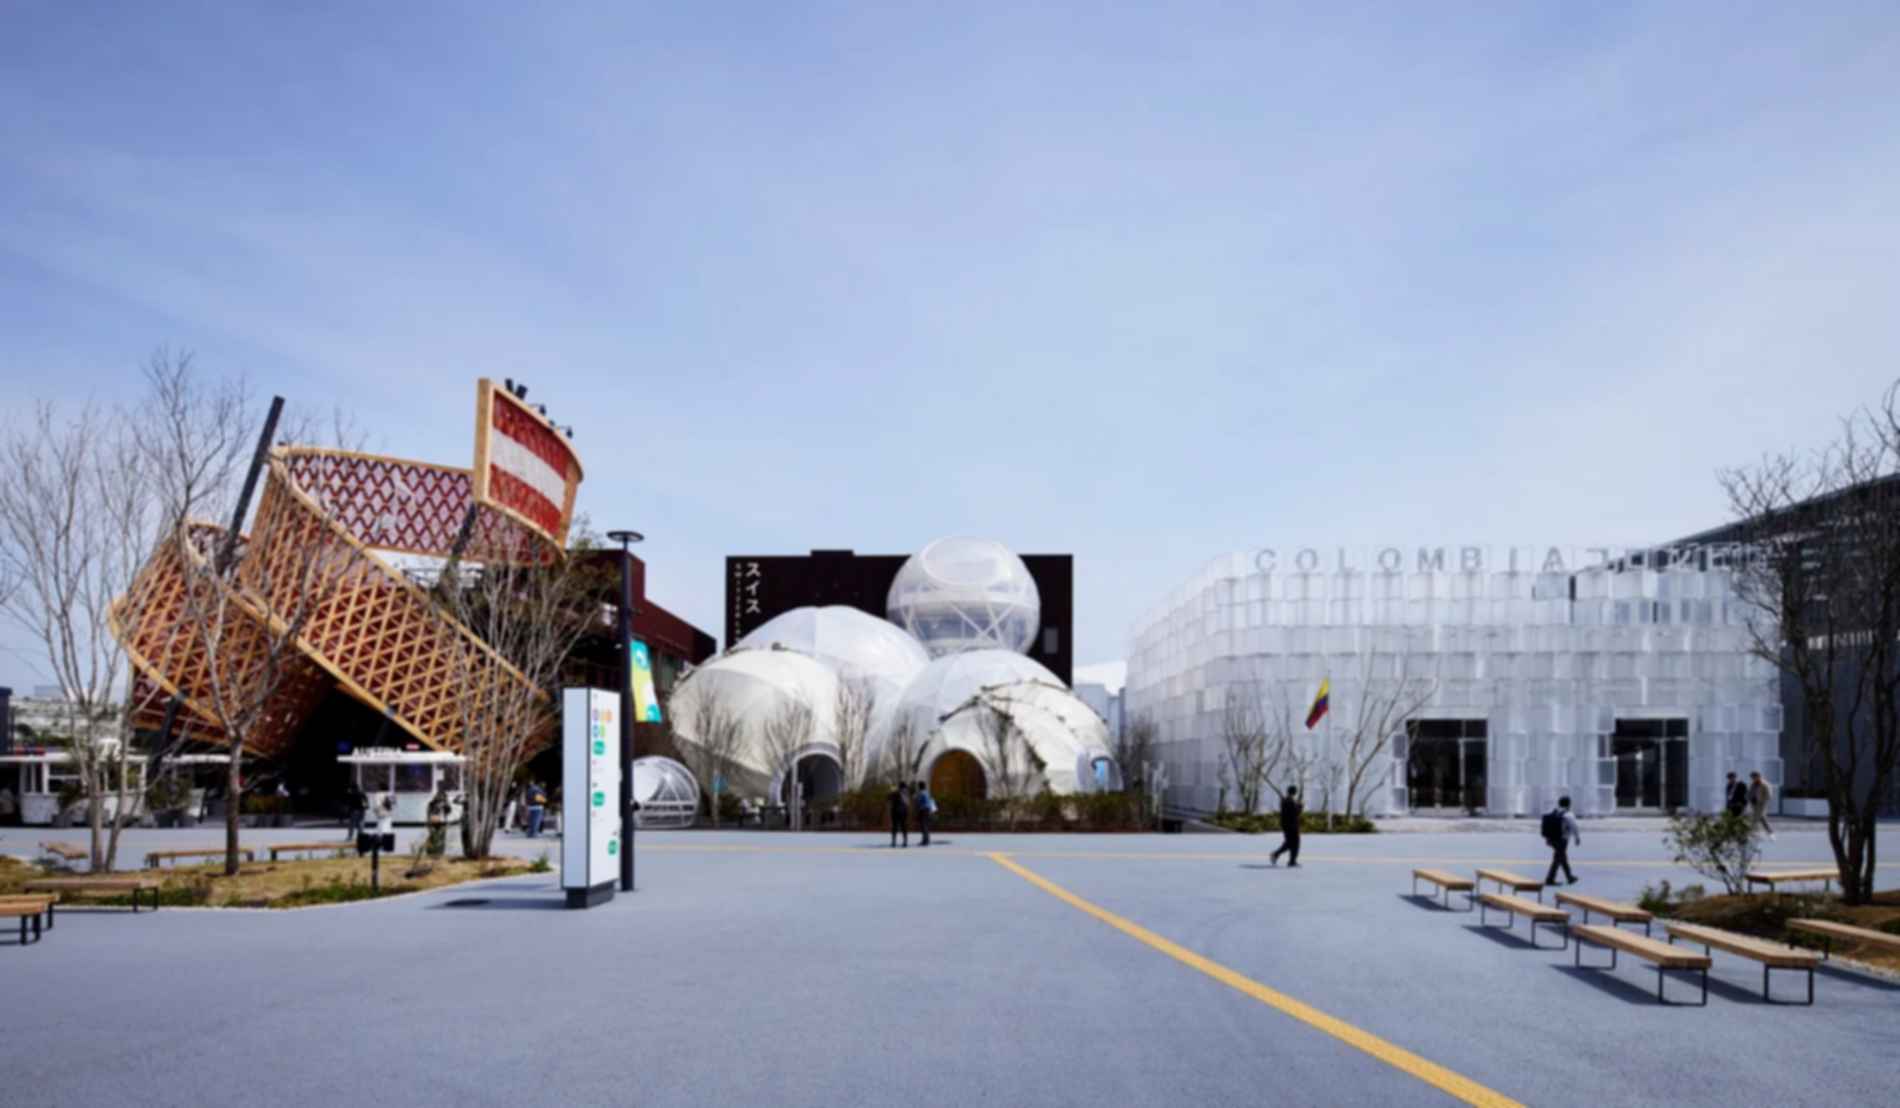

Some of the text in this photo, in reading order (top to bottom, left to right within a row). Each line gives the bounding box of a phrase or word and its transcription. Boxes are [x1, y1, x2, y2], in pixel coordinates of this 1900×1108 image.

[1255, 547, 1564, 571] COLOMBIA
[746, 562, 761, 614] スイス
